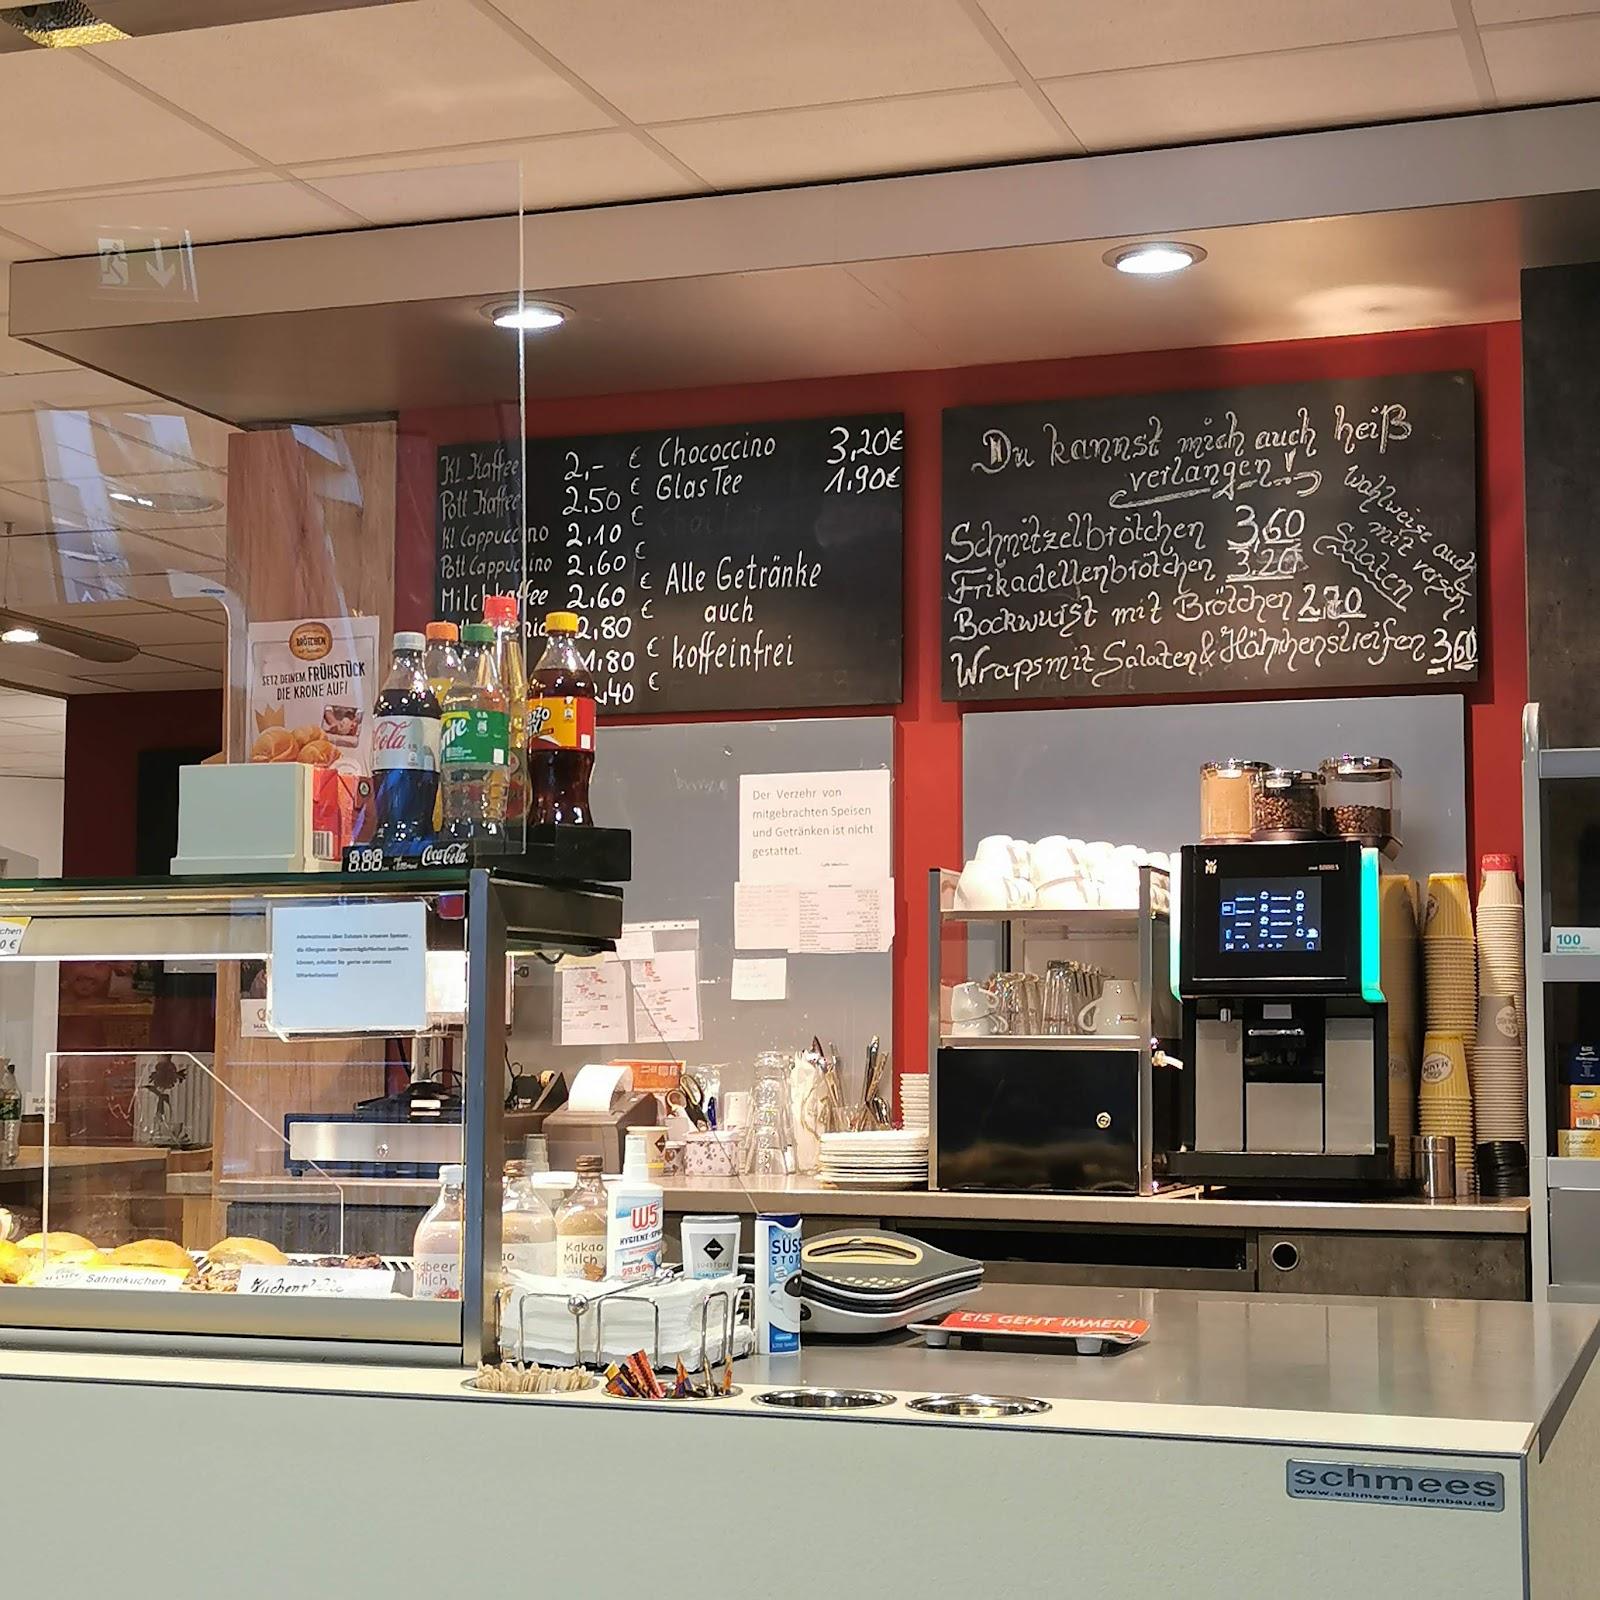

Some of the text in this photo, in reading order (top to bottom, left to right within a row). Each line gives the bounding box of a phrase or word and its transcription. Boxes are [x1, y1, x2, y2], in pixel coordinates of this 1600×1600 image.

[658, 430, 776, 467] Chococcino
[971, 404, 1412, 474] Du kannst mich auch heiß
[467, 448, 519, 482] Kaffee
[628, 446, 642, 469] €
[655, 468, 709, 500] Glas
[711, 464, 743, 496] Tee
[439, 489, 468, 522] Pott
[472, 484, 521, 519] Kaffee
[630, 477, 641, 496] €
[460, 524, 550, 553] Cappuccno
[631, 505, 644, 527] €
[944, 510, 1207, 569] Schnitzelbrötchen
[439, 554, 467, 580] Pott
[468, 553, 553, 580] Cappucino
[634, 541, 646, 560] €
[665, 552, 822, 596] Alle Getränke
[640, 572, 652, 590] €
[947, 550, 1217, 605] Frikadellenbrötchen
[641, 600, 654, 619] €
[704, 595, 754, 623] auch
[949, 594, 1099, 642] Bockwurst
[1111, 591, 1163, 626] mit
[1172, 580, 1294, 624] Brötchen
[647, 637, 658, 657] €
[672, 629, 794, 675] koffeinfrei
[262, 660, 366, 687] SETZ DEINEM FRÜHSTÜCK
[648, 671, 660, 690] €
[277, 685, 291, 700] DIE
[294, 684, 324, 699] KRONE
[752, 788, 842, 801] Der Verzehr von
[752, 806, 871, 821] mitgebrachten Speisen
[752, 824, 874, 838] und Getränken ist nicht
[1556, 933, 1581, 945] 100
[632, 1203, 658, 1230] W5
[563, 1253, 598, 1265] Milch
[565, 1242, 604, 1252] Kakao
[86, 1273, 167, 1287] Sahnekuchen
[960, 1312, 1137, 1330] EIS GEHT IMMER!
[1293, 1467, 1498, 1498] schmees
[1293, 1487, 1497, 1508] www.schmees-ladenbau.de
